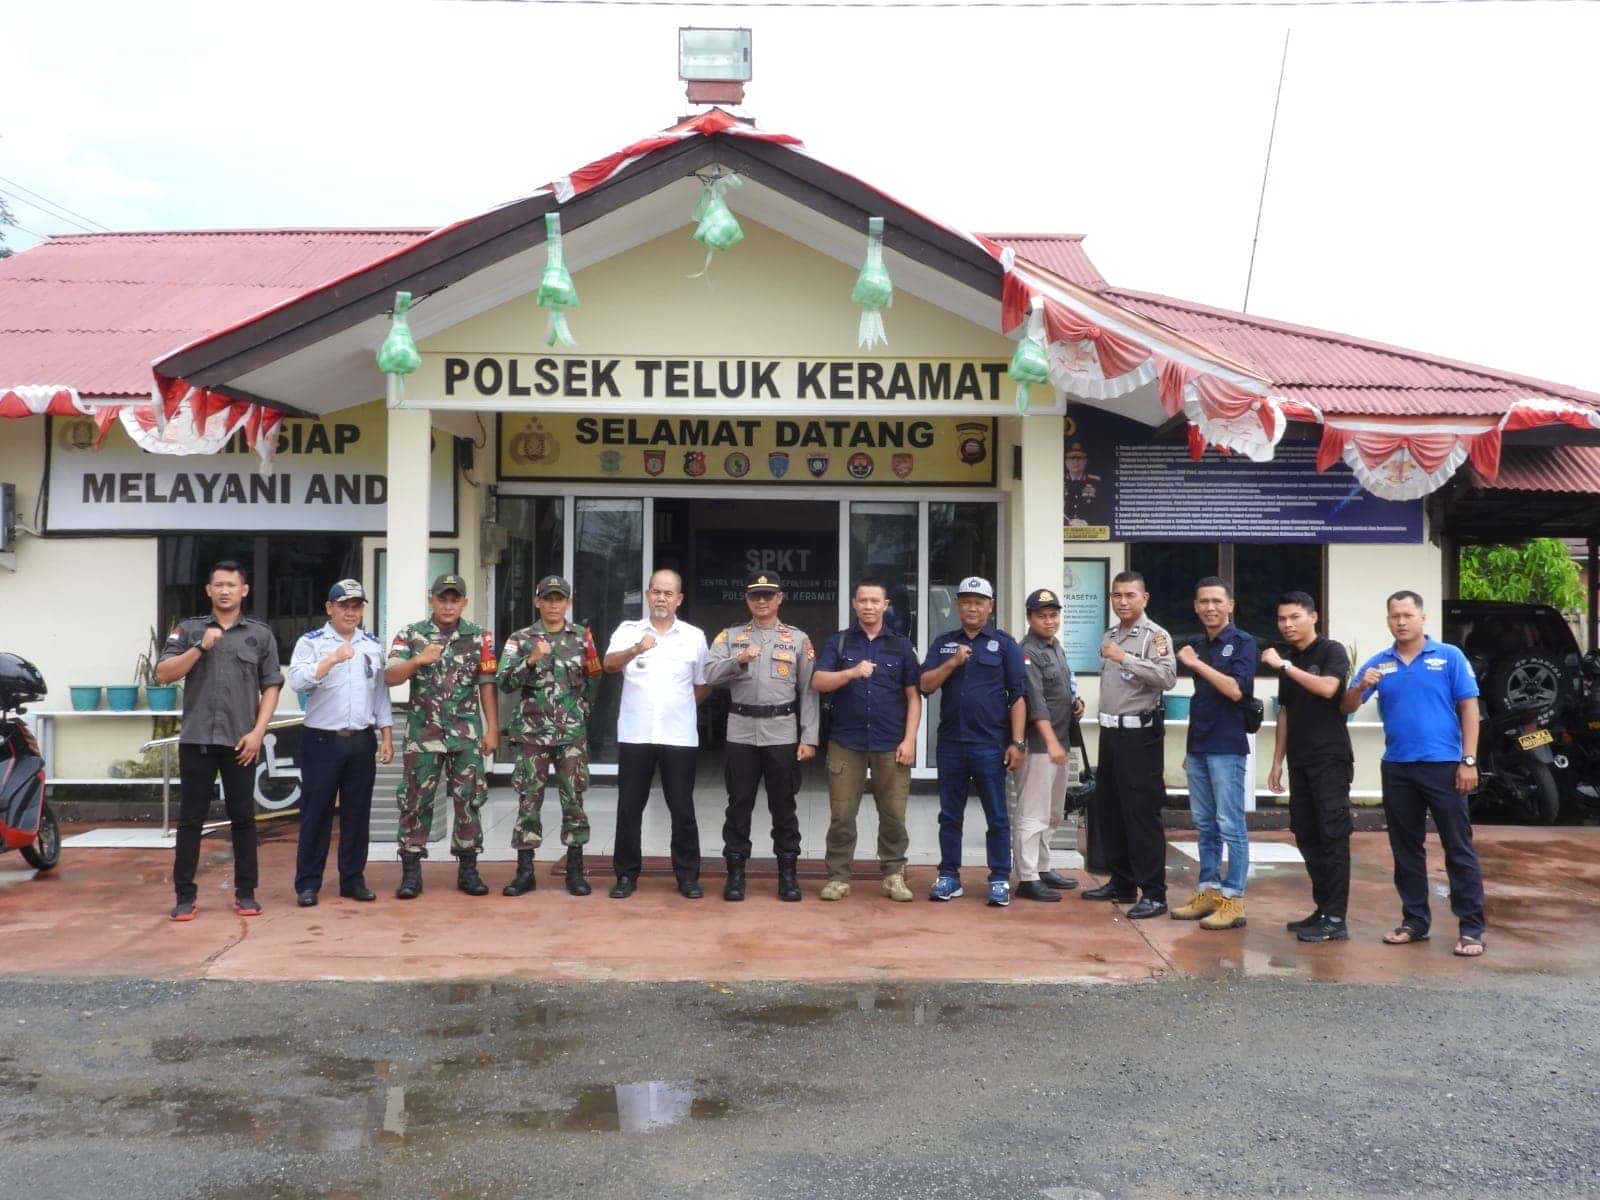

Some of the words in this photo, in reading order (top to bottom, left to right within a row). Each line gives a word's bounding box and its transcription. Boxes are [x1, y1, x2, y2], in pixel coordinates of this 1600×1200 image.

[445, 358, 621, 397] POLSEK
[635, 360, 781, 399] TELUK
[797, 362, 1008, 401] KERAMAT
[575, 417, 761, 447] SELAMAT
[776, 420, 934, 449] DATANG
[82, 472, 290, 505] MELAYANI
[745, 548, 811, 573] SPKT
[774, 643, 796, 651] POLRI
